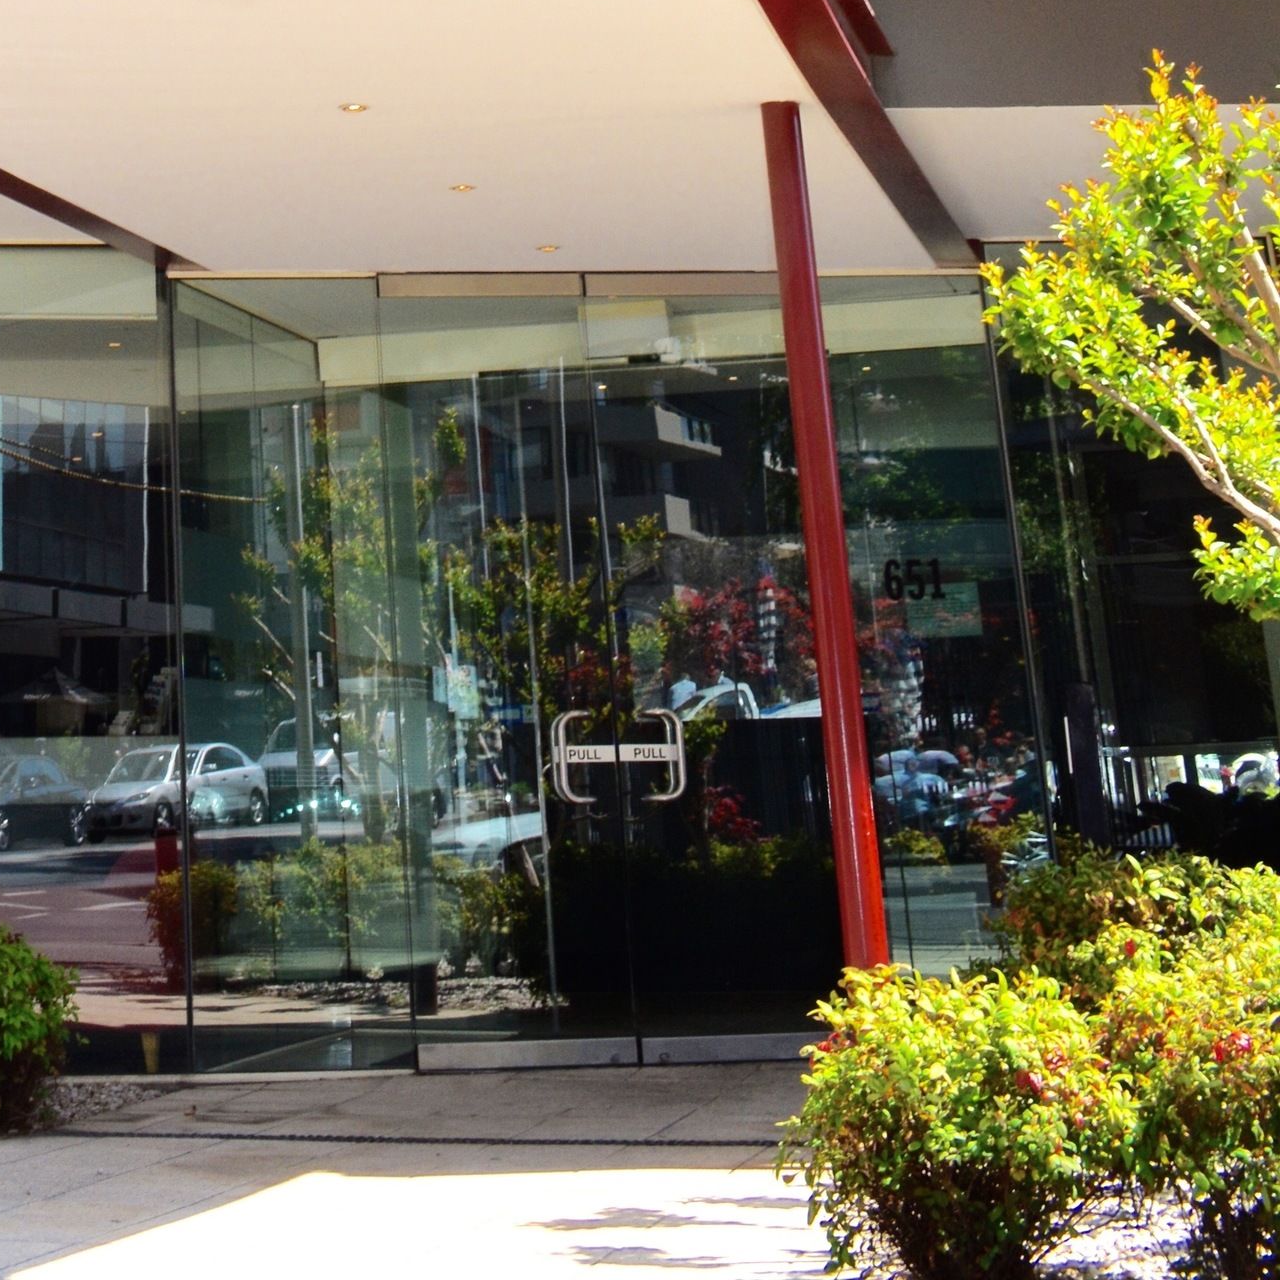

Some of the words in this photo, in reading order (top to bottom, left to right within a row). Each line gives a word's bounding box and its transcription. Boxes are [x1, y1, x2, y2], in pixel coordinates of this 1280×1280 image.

[884, 558, 946, 600] 651
[568, 749, 602, 760] PULL
[633, 747, 667, 759] PULL
